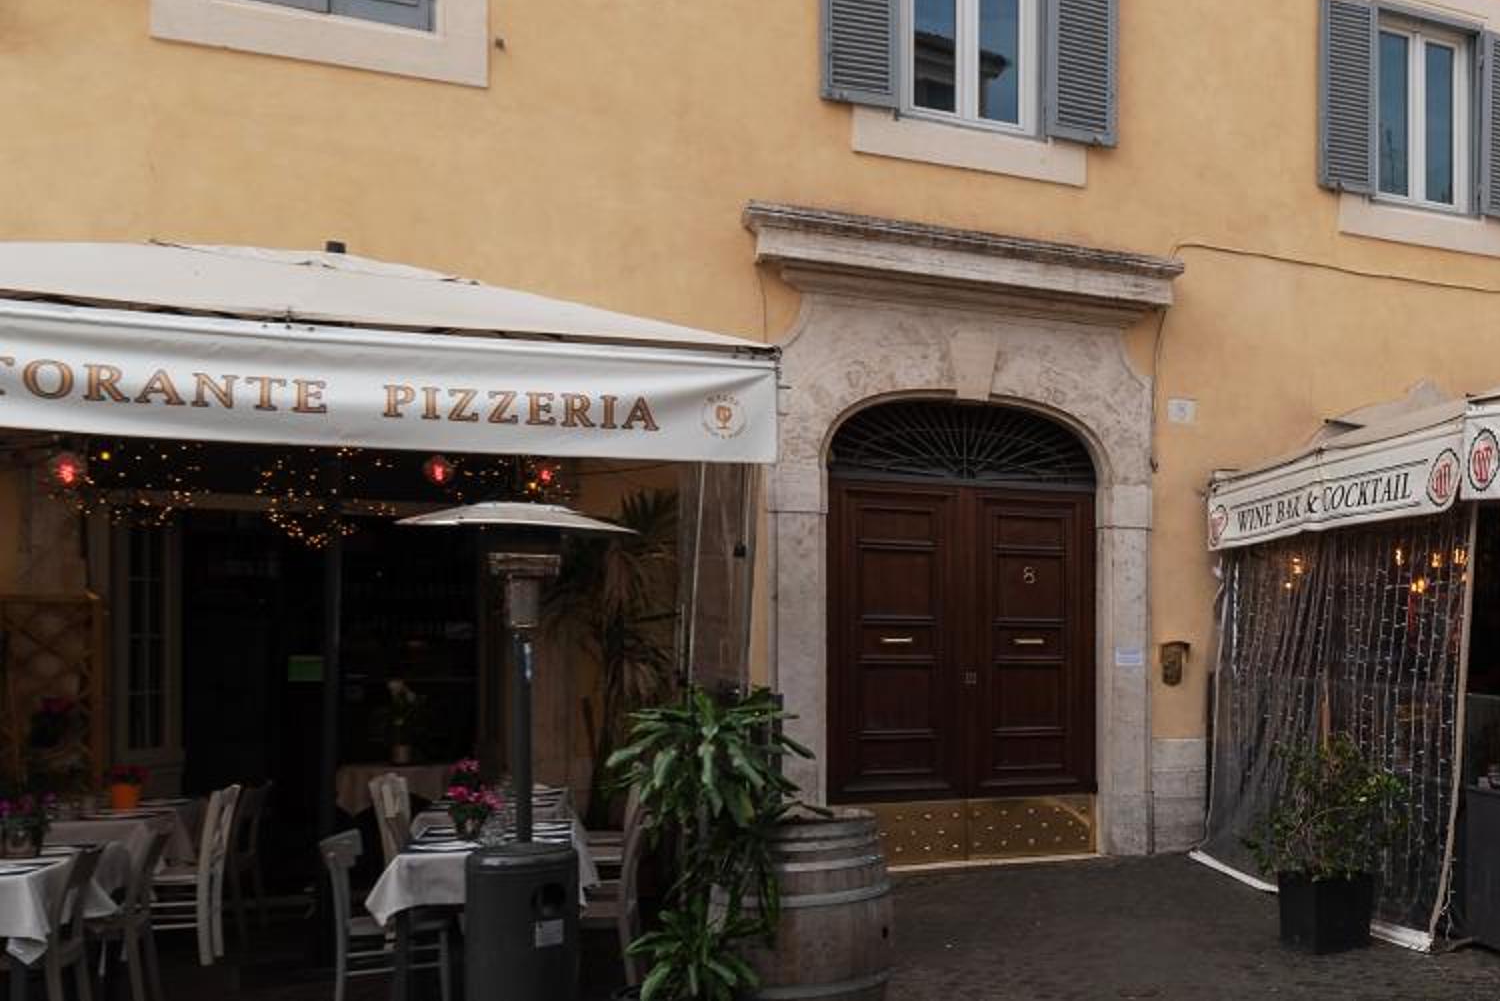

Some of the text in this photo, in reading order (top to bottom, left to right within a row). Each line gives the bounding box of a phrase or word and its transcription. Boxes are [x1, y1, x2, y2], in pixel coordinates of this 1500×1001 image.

[383, 384, 660, 431] PIZZERIA
[1237, 504, 1273, 532] WINE
[1304, 490, 1318, 514] &
[1322, 473, 1412, 512] COCKTAIL
